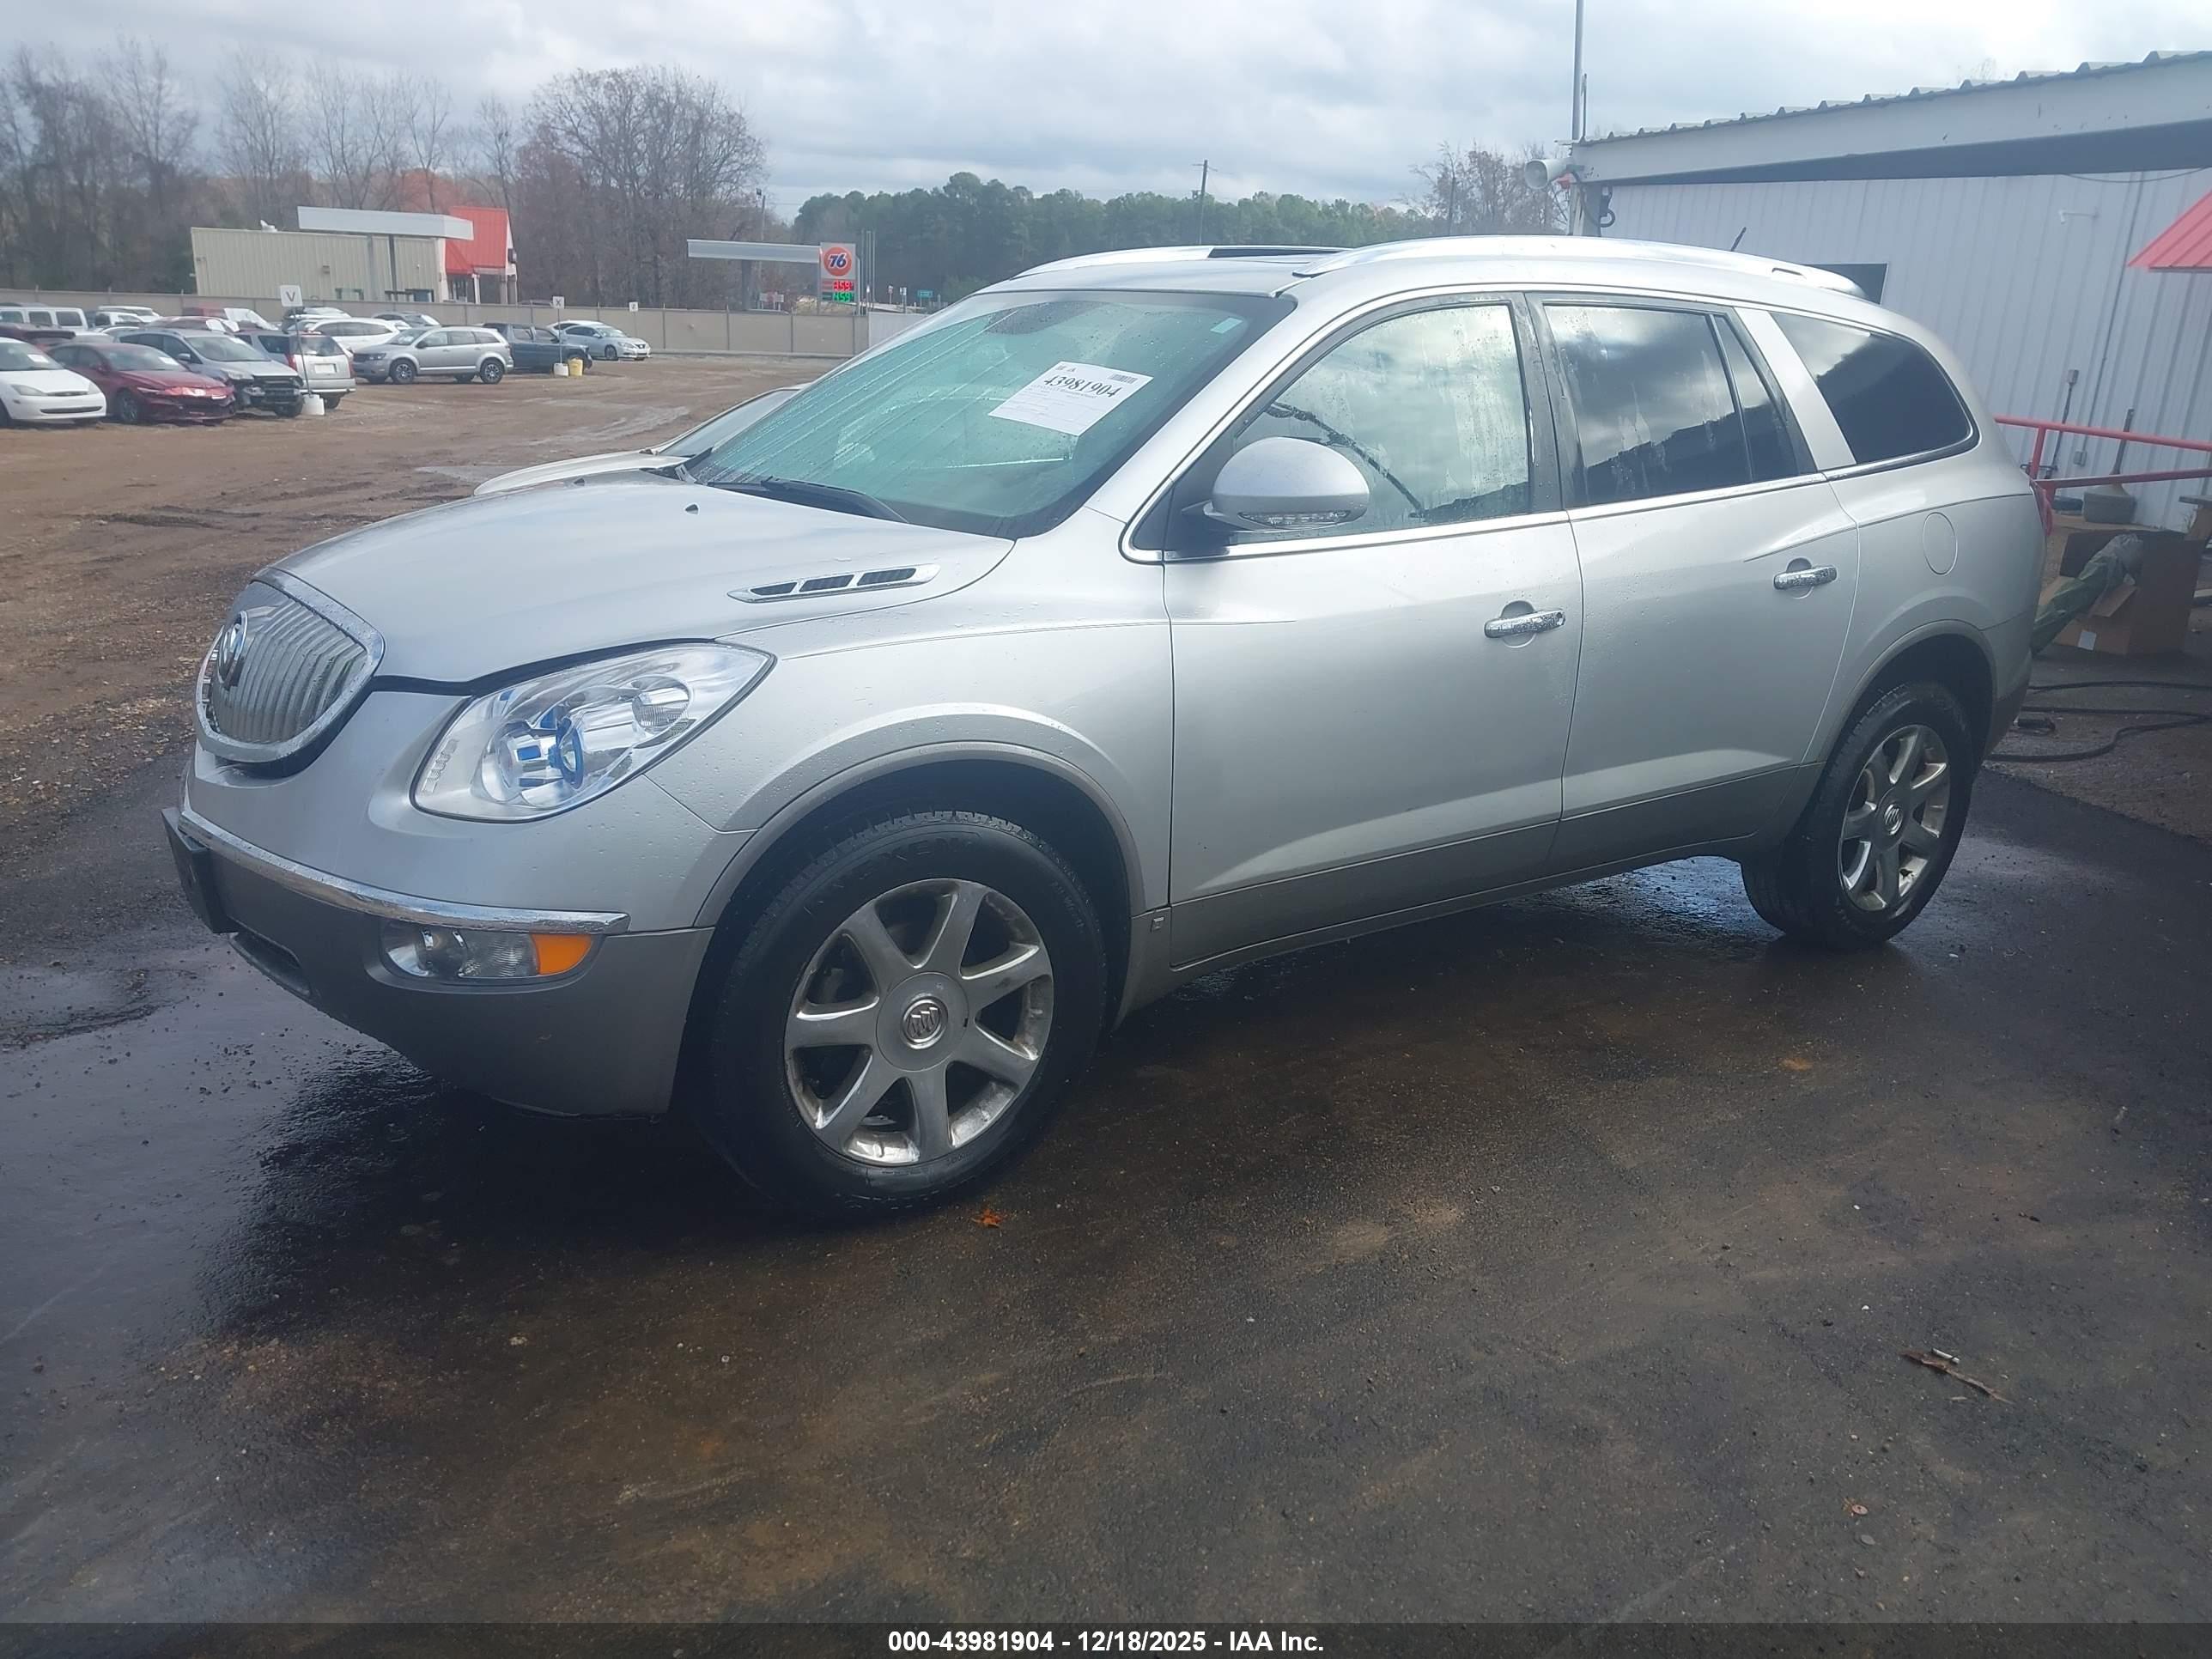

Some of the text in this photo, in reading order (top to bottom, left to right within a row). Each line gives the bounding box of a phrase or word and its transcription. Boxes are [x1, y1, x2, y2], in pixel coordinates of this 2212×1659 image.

[829, 253, 847, 268] 76
[286, 291, 295, 301] V
[1044, 375, 1122, 398] 43981904
